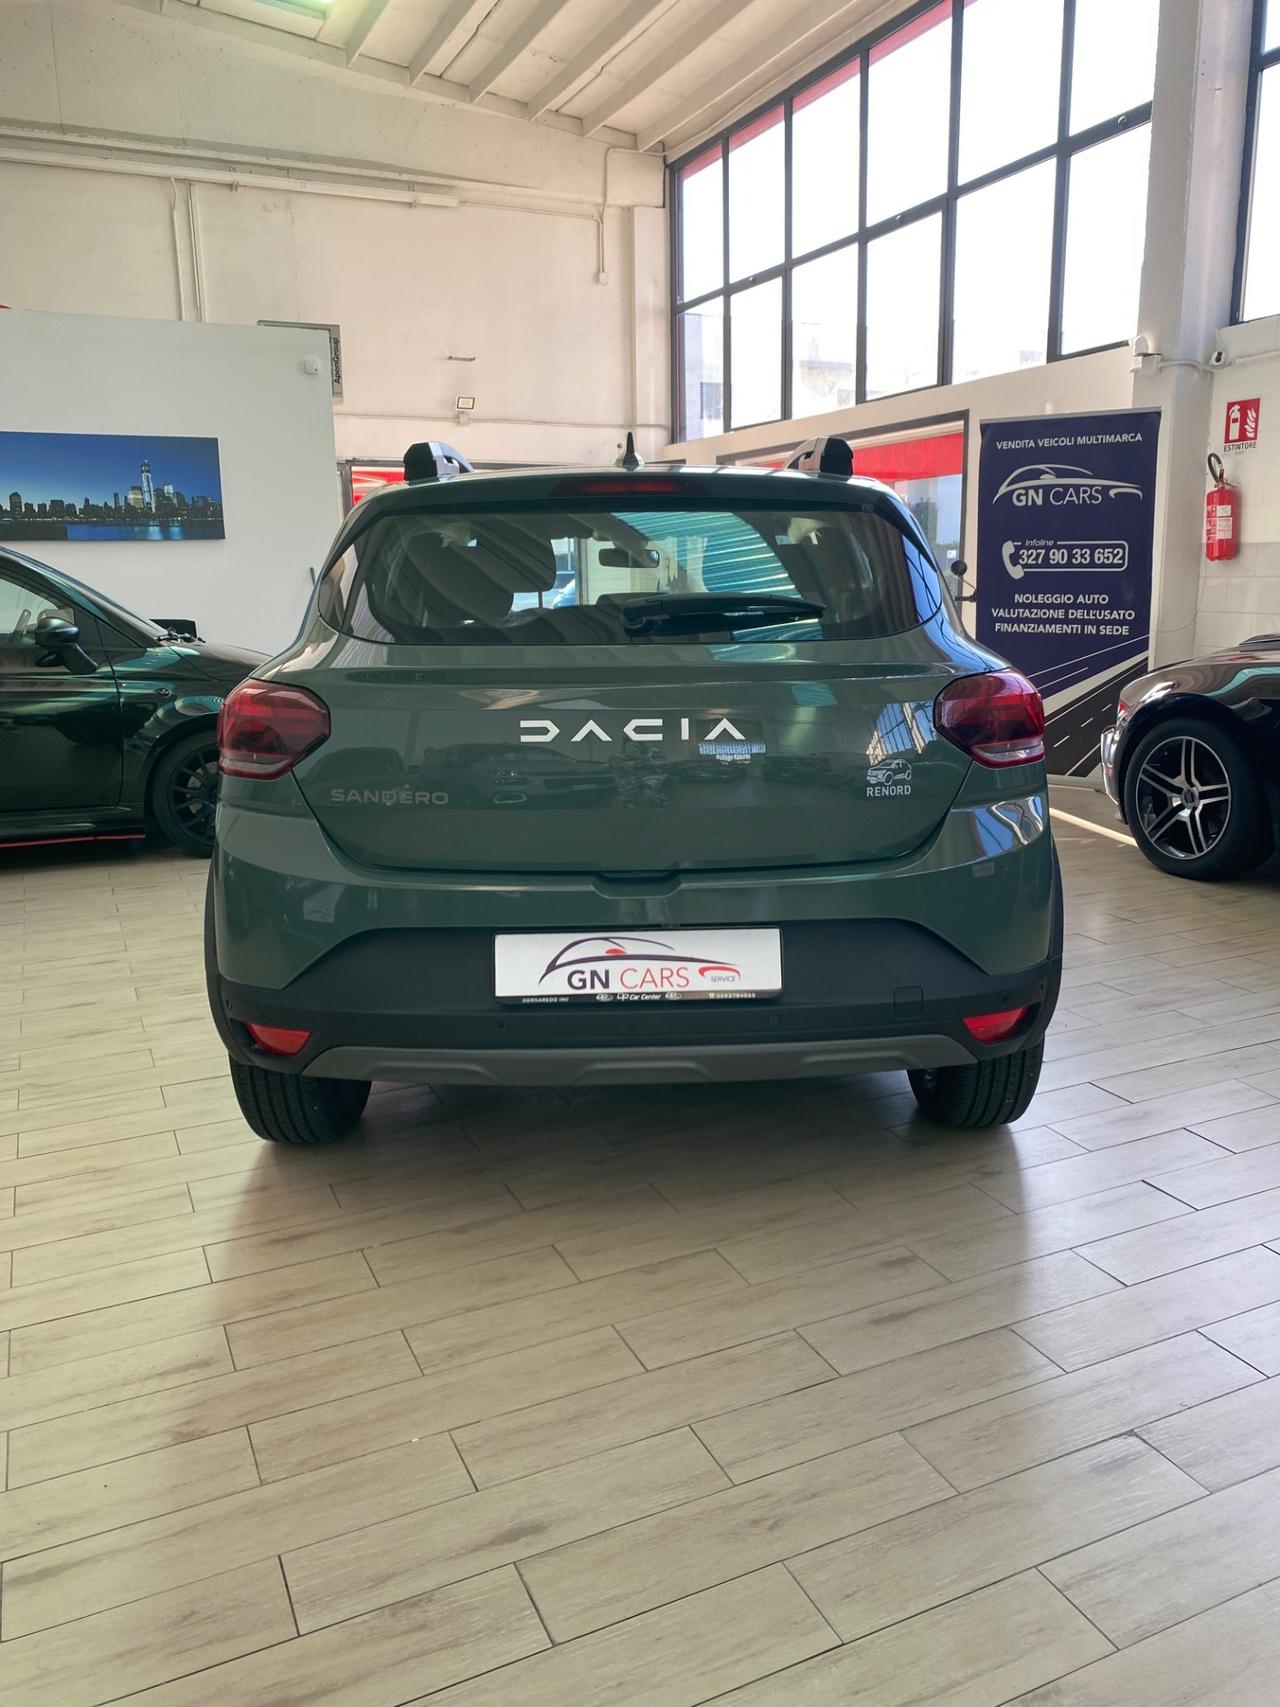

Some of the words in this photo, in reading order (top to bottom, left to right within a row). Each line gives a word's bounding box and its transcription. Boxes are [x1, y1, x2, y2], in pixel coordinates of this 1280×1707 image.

[996, 440, 1036, 450] VENDITA
[1038, 436, 1075, 448] VEICOLI
[1077, 433, 1142, 445] MULTIMARCA
[1224, 442, 1257, 452] ESTINTORE
[1012, 488, 1043, 507] GN
[1049, 486, 1102, 505] CARS
[1025, 539, 1054, 548] Infoline
[1019, 550, 1044, 565] 327
[1049, 549, 1068, 565] 90
[1072, 549, 1090, 564] 33
[1094, 548, 1123, 564] 652
[1014, 594, 1074, 605] NOLEGGIO
[1076, 594, 1109, 605] AUTO
[991, 608, 1065, 620] VALUTAZIONE
[1068, 610, 1135, 621] DELL'USATO
[995, 623, 1081, 634] FINANZIAMENTI
[1084, 625, 1097, 634] IN
[1099, 626, 1130, 636] SEDE
[519, 717, 747, 742] DACIA
[330, 788, 449, 805] SANDERO
[866, 785, 912, 797] RENORD
[567, 970, 610, 990] GN
[619, 967, 690, 989] CARS
[710, 975, 736, 983] SERVICE
